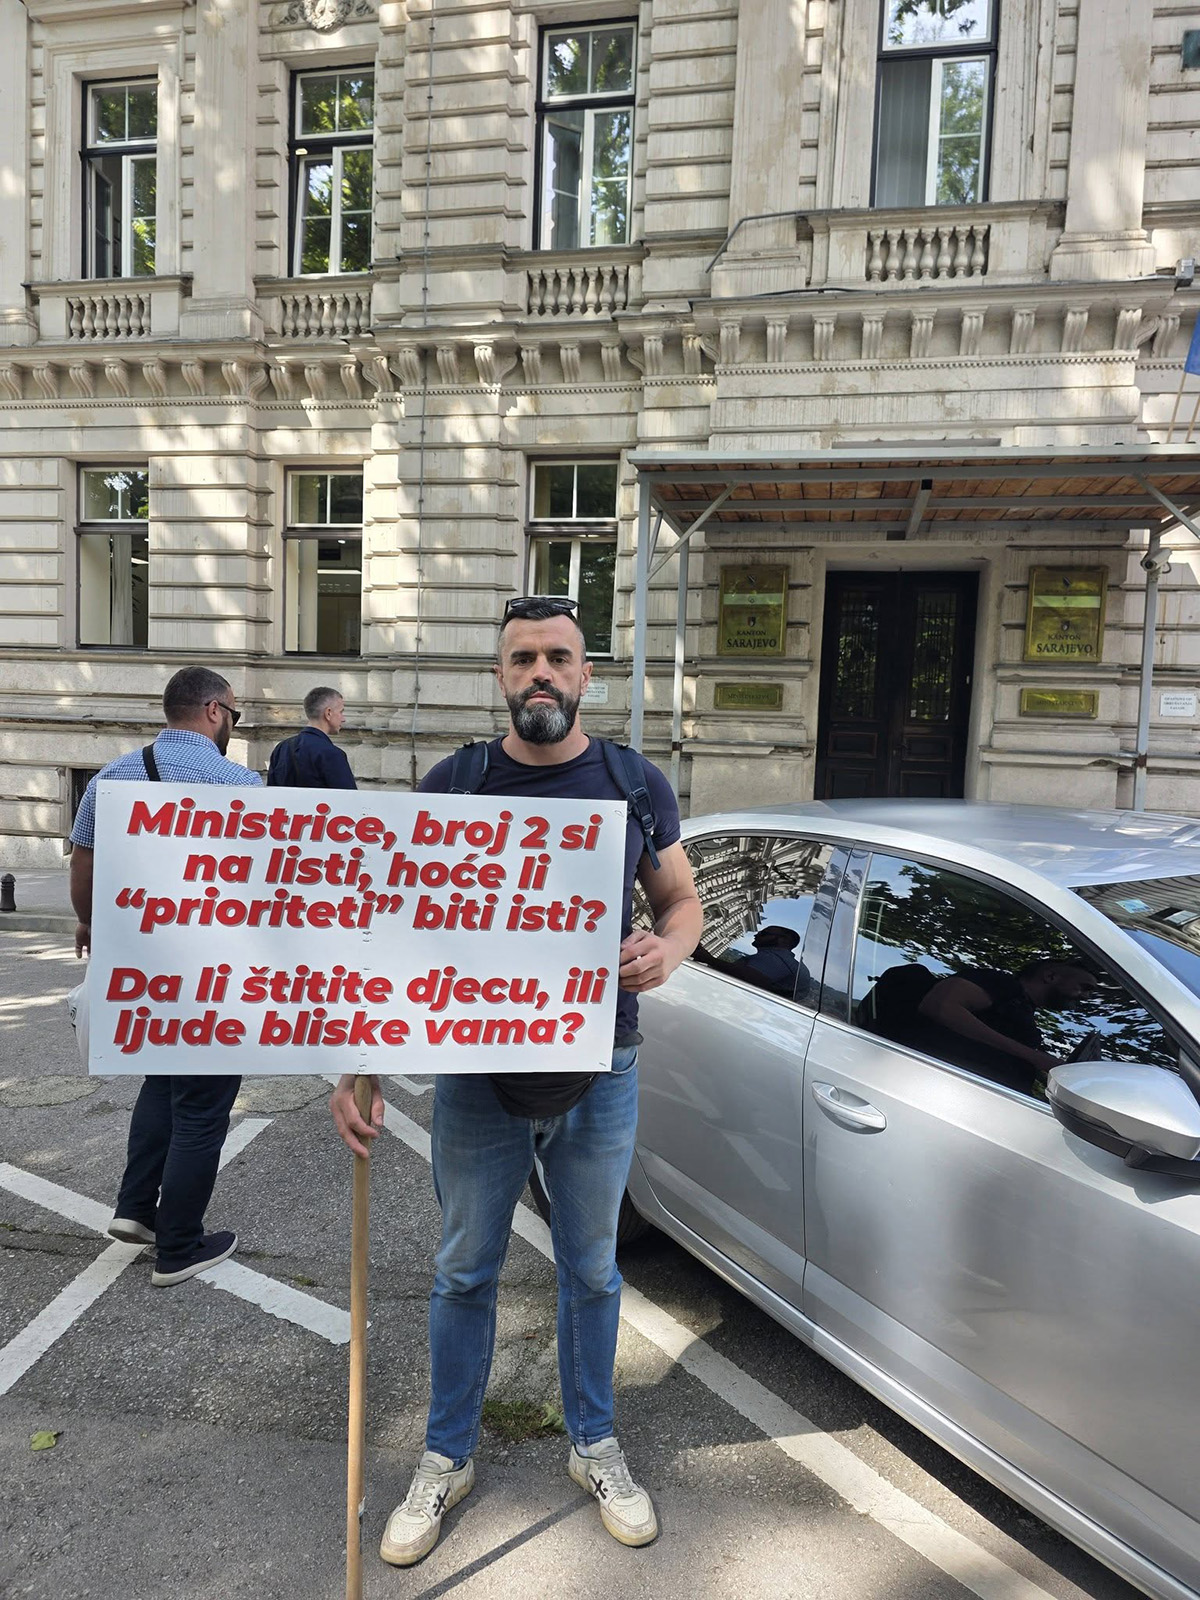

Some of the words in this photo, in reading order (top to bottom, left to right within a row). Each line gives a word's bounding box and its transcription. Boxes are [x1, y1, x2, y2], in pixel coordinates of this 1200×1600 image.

[727, 638, 777, 650] SARAJEVO
[1036, 643, 1093, 655] SARAJEVO
[128, 798, 397, 850] Ministrice,
[412, 811, 513, 855] broj
[521, 817, 550, 848] 2
[561, 815, 602, 850] si
[184, 855, 253, 882] na
[266, 846, 372, 892] listi,
[388, 853, 507, 889] hoće
[519, 854, 552, 889] li
[413, 893, 499, 930] biti
[507, 894, 607, 931] isti?
[107, 968, 183, 1001] Da
[196, 964, 233, 1002] li
[242, 965, 393, 1003] štitite
[407, 967, 550, 1011] djecu,
[563, 968, 609, 1003] ili
[114, 1007, 246, 1054] ljude
[260, 1008, 410, 1045] bliske
[426, 1013, 586, 1045] vama?
